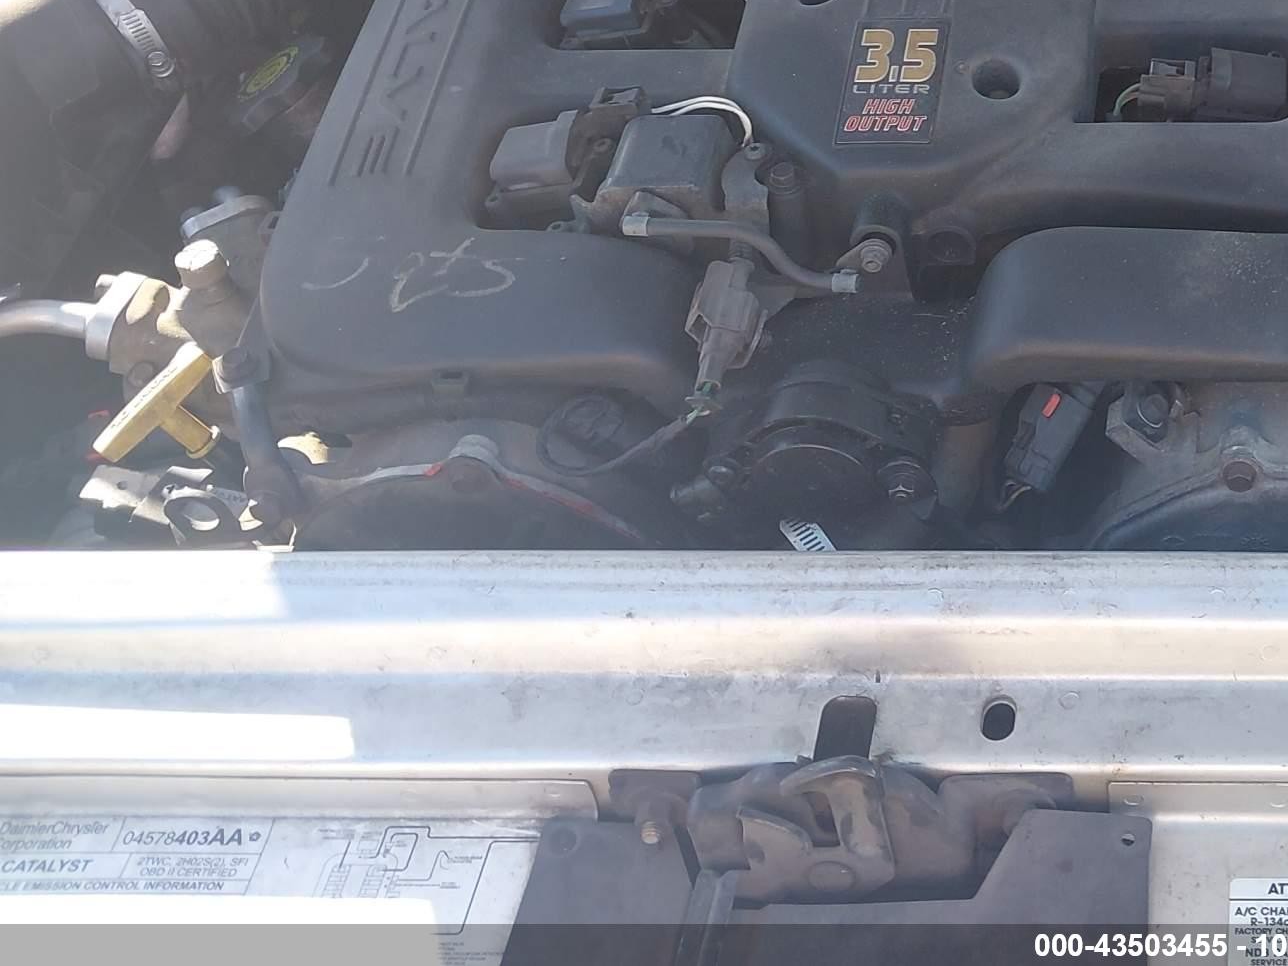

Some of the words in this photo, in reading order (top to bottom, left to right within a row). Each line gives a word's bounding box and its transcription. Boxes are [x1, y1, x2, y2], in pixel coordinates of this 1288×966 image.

[853, 28, 940, 83] 3.5
[852, 84, 930, 95] LITER
[862, 98, 916, 115] HIGH
[843, 115, 927, 132] OUTPUT
[123, 828, 242, 846] 04578403AA
[1, 859, 94, 873] CATALYST
[140, 868, 165, 877] OBD
[176, 868, 237, 877] CERTIFIED
[83, 881, 140, 891] CONTROL
[143, 881, 224, 891] INFORMATION
[1234, 906, 1257, 916] A/C
